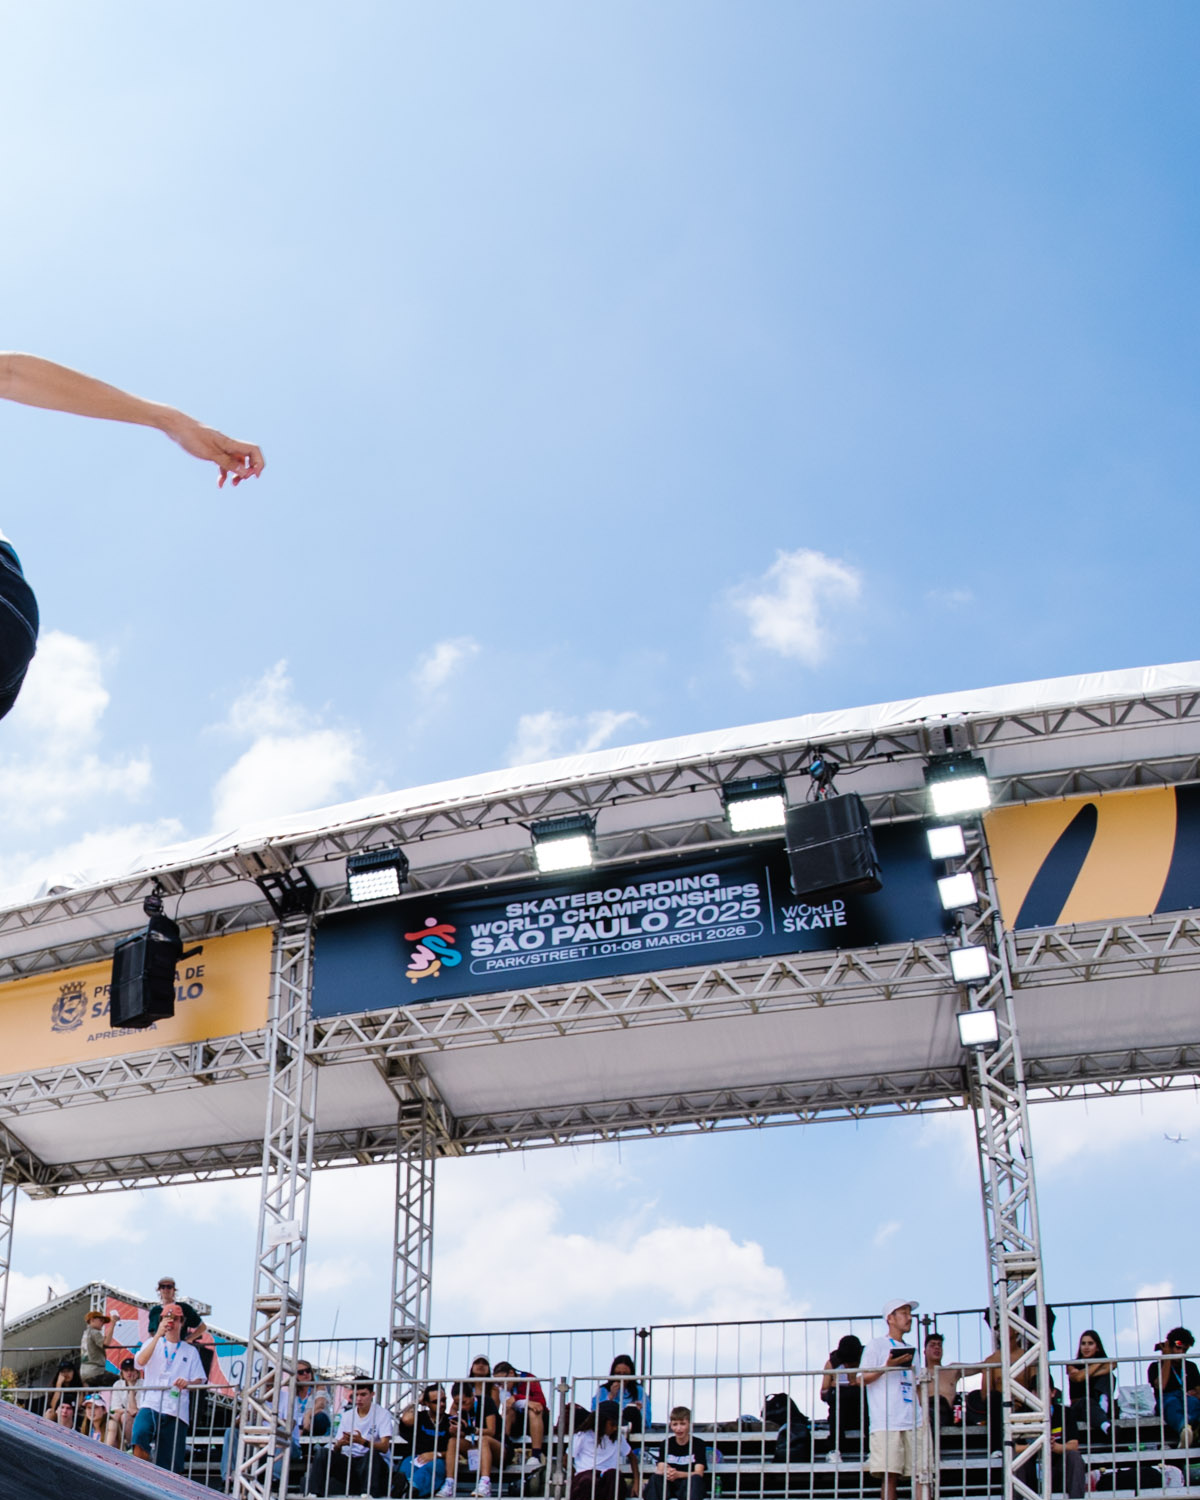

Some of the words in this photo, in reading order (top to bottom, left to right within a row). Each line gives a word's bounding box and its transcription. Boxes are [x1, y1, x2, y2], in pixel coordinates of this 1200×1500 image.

[471, 913, 554, 938] WORLD
[562, 883, 759, 924] CHAMPIONSHIPS
[506, 873, 720, 917] SKATEBOARDING
[781, 899, 845, 918] WORLD
[470, 930, 545, 957] SÃO
[551, 912, 669, 946] PAULO
[674, 899, 761, 929] 2025
[783, 911, 847, 933] SKATE
[486, 946, 589, 970] PARK/STREET
[600, 940, 642, 954] 01-08
[645, 932, 702, 948] MARCH
[706, 925, 746, 940] 2026
[185, 965, 205, 979] DE
